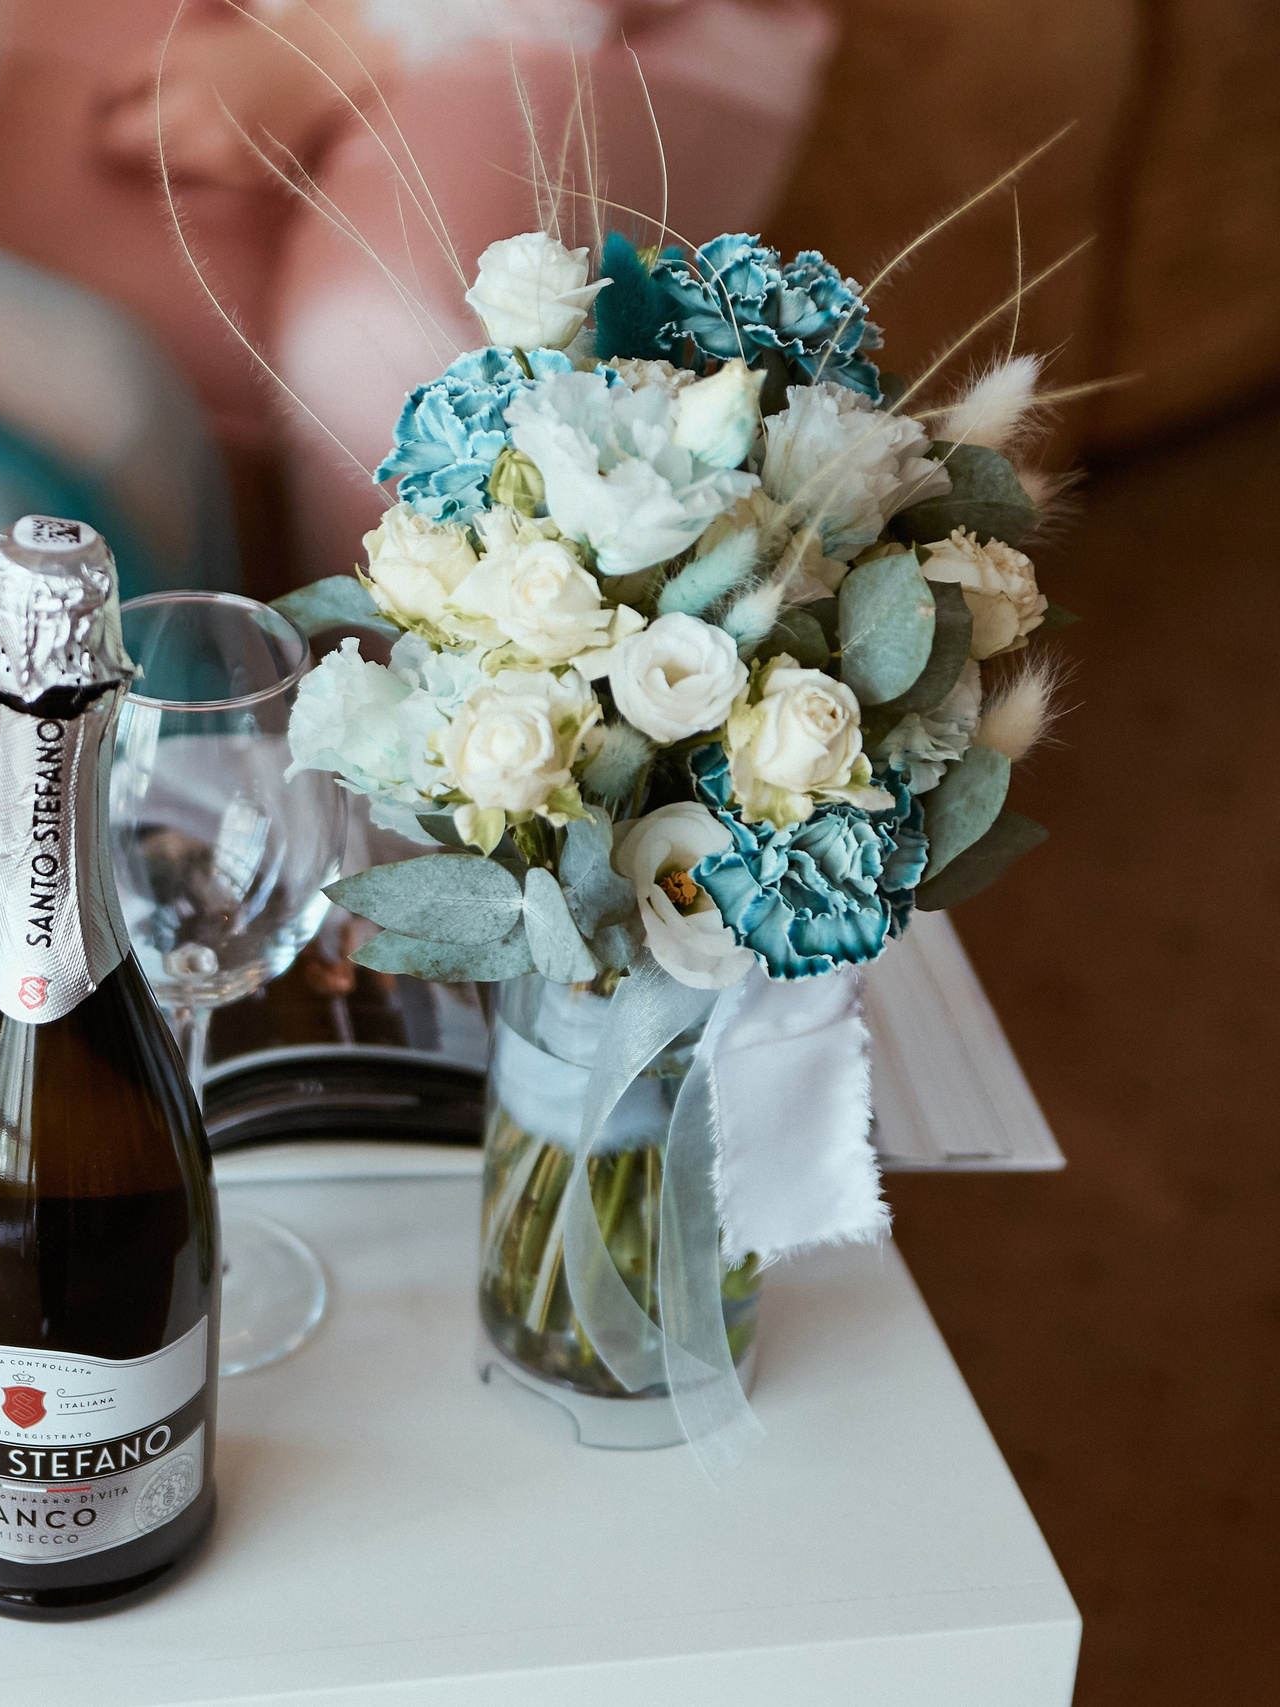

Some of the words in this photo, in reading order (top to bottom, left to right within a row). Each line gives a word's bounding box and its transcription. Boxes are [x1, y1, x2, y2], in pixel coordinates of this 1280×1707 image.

[32, 718, 65, 843] STEFANO
[26, 853, 59, 948] SANTO
[10, 1359, 92, 1375] CONTROLLATA
[60, 1396, 115, 1409] ITALIANA
[16, 1431, 92, 1440] REGISTRATO
[8, 1425, 172, 1478] STEFANO
[99, 1486, 129, 1501] VITA
